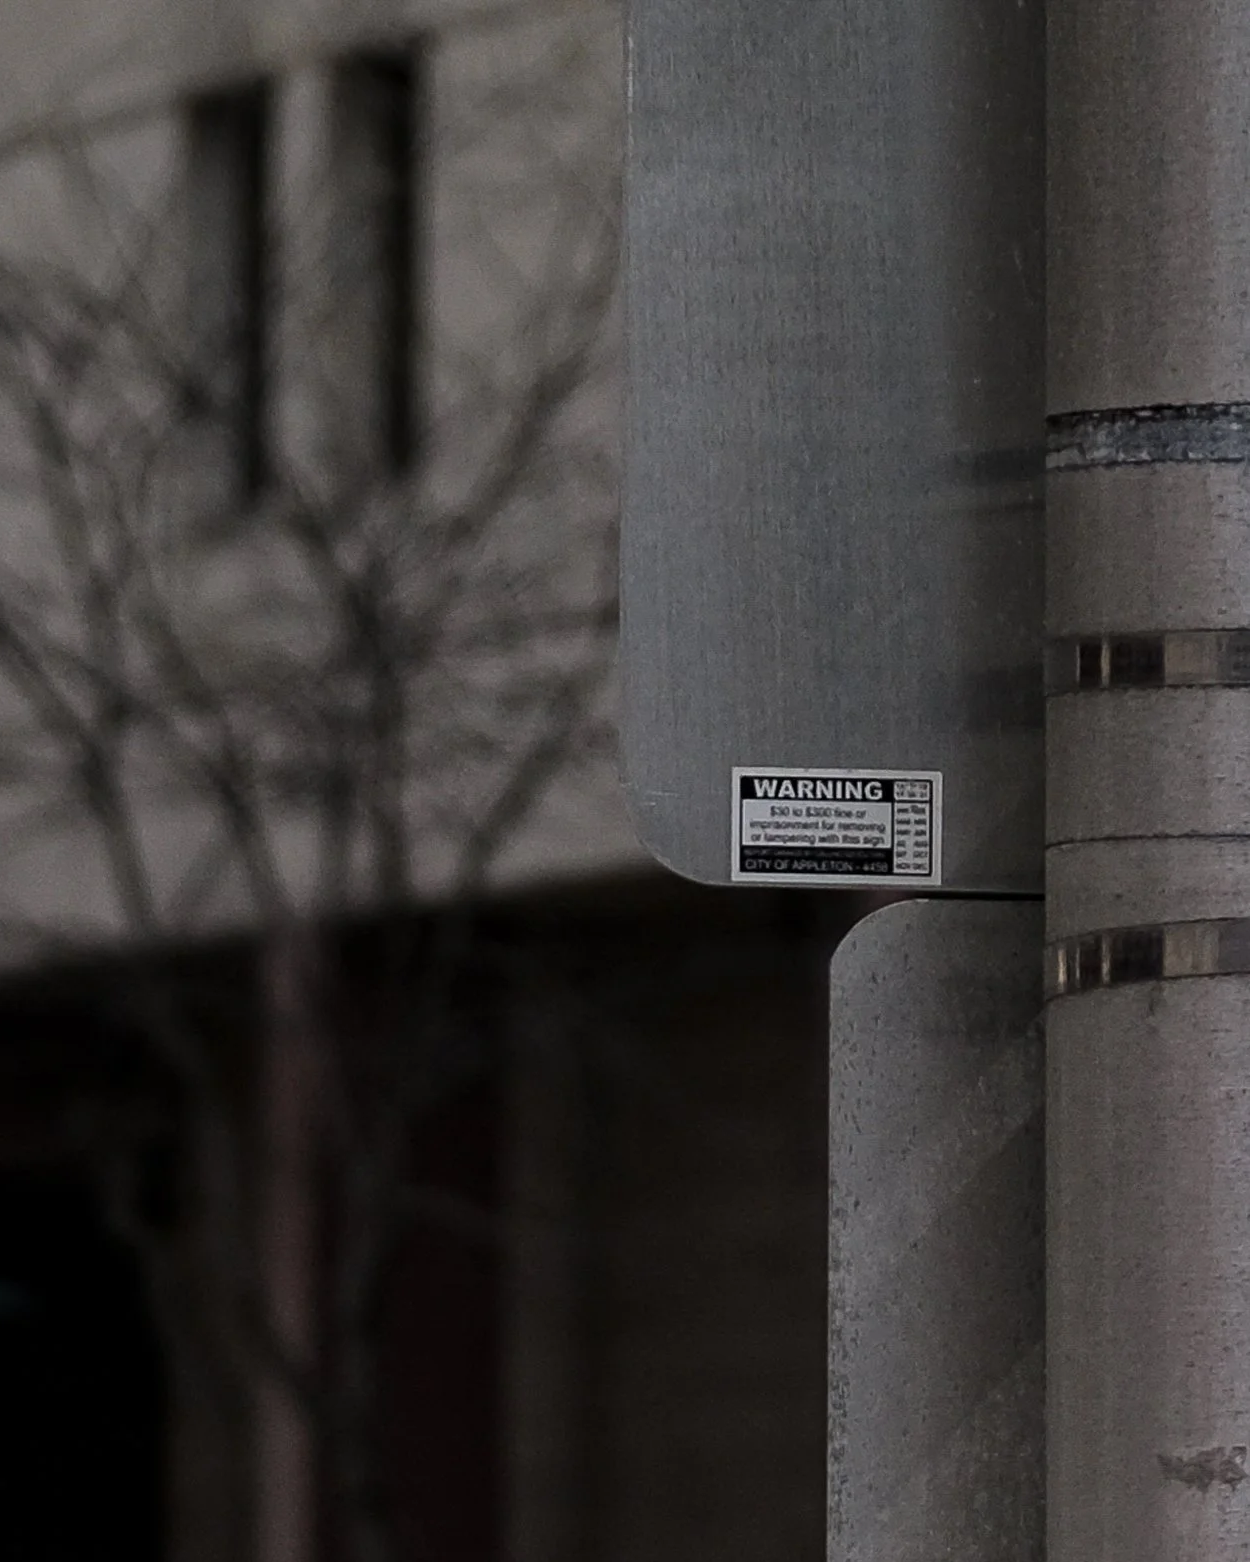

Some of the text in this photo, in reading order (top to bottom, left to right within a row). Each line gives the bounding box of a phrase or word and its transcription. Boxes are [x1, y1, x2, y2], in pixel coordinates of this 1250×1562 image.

[753, 779, 883, 800] WARNING
[749, 820, 886, 834] imprisonment for removing
[764, 833, 816, 845] tampering
[818, 834, 840, 843] with
[842, 835, 860, 844] this
[745, 859, 771, 870] CITY
[775, 860, 791, 871] OF
[792, 860, 853, 872] APPLETON
